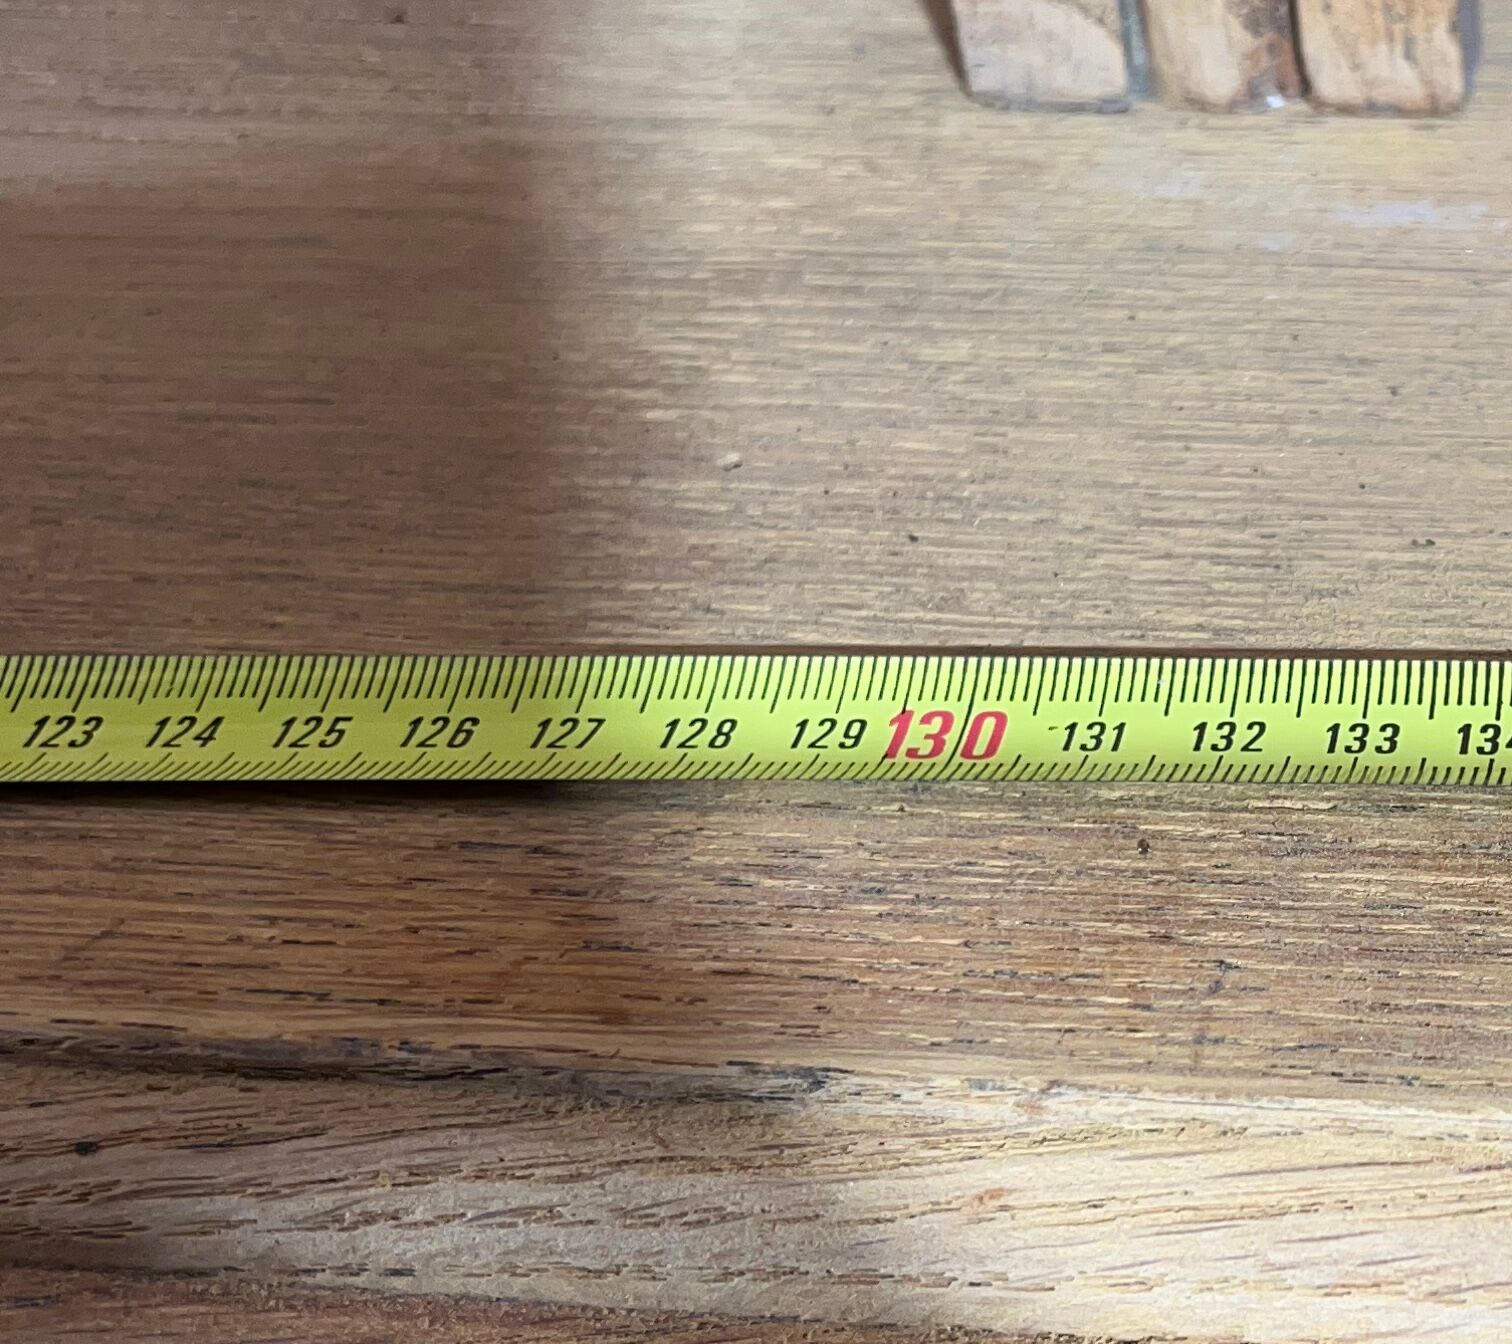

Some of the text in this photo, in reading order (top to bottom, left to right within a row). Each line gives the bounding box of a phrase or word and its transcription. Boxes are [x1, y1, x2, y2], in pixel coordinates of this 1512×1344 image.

[22, 715, 104, 749] 123
[145, 715, 225, 749] 124
[271, 715, 354, 749] 125
[399, 715, 481, 749] 126
[529, 717, 607, 750] 127
[659, 717, 738, 750] 128
[789, 717, 868, 750] 129
[883, 709, 1009, 761] 130
[1061, 721, 1127, 753] 131
[1191, 720, 1267, 753] 132
[1325, 722, 1401, 755] 133
